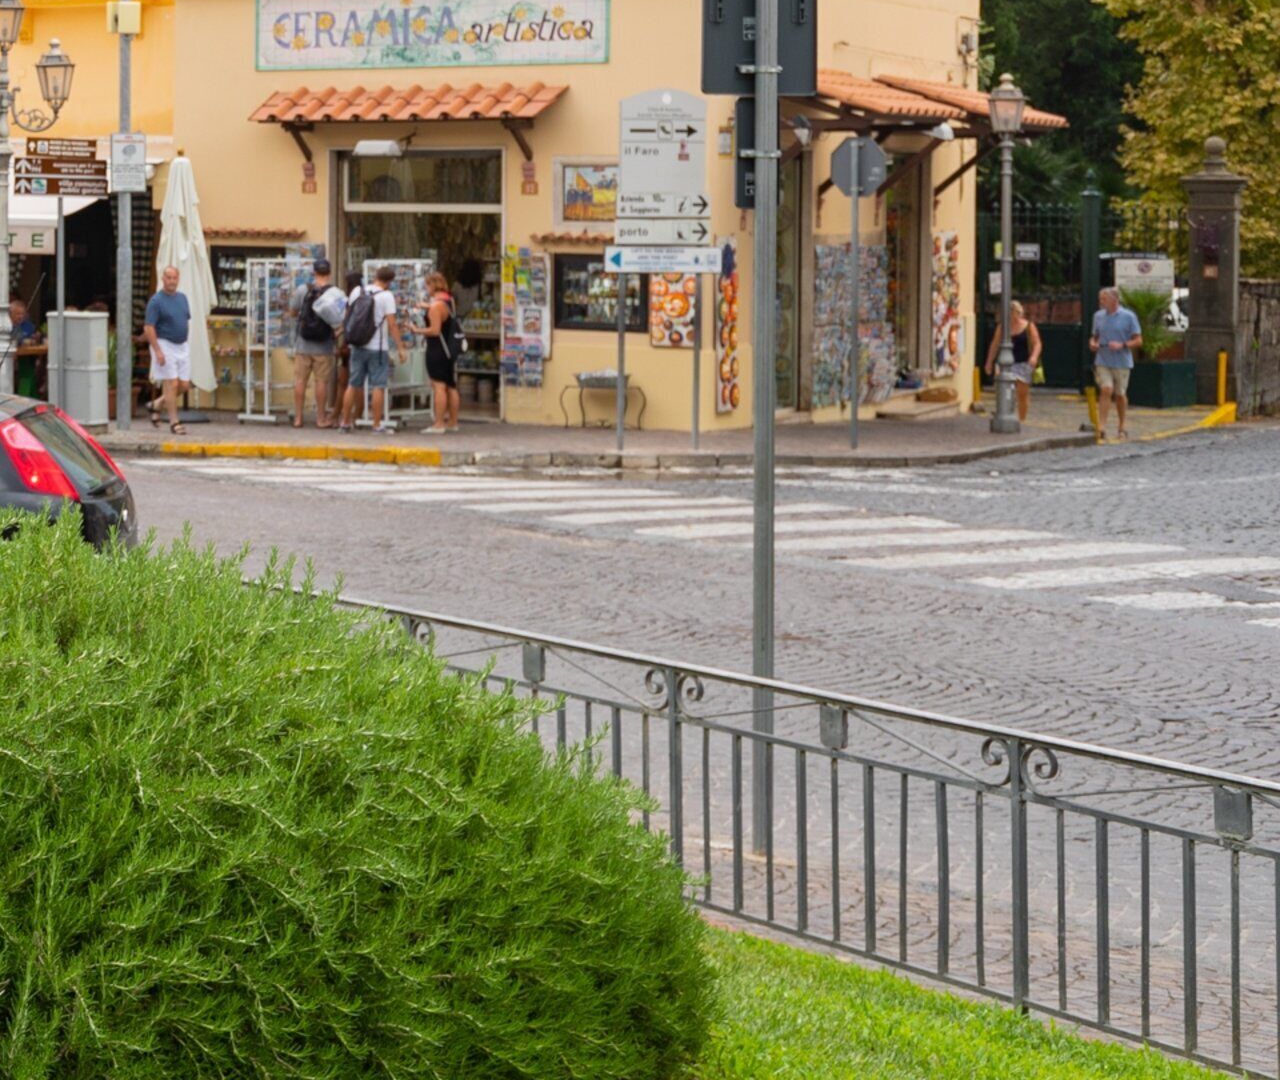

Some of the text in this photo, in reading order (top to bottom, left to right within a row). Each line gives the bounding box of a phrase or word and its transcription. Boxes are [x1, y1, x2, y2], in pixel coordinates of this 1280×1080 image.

[272, 5, 594, 49] CERAMICA artistica
[634, 146, 660, 156] Faro
[620, 227, 649, 238] porto
